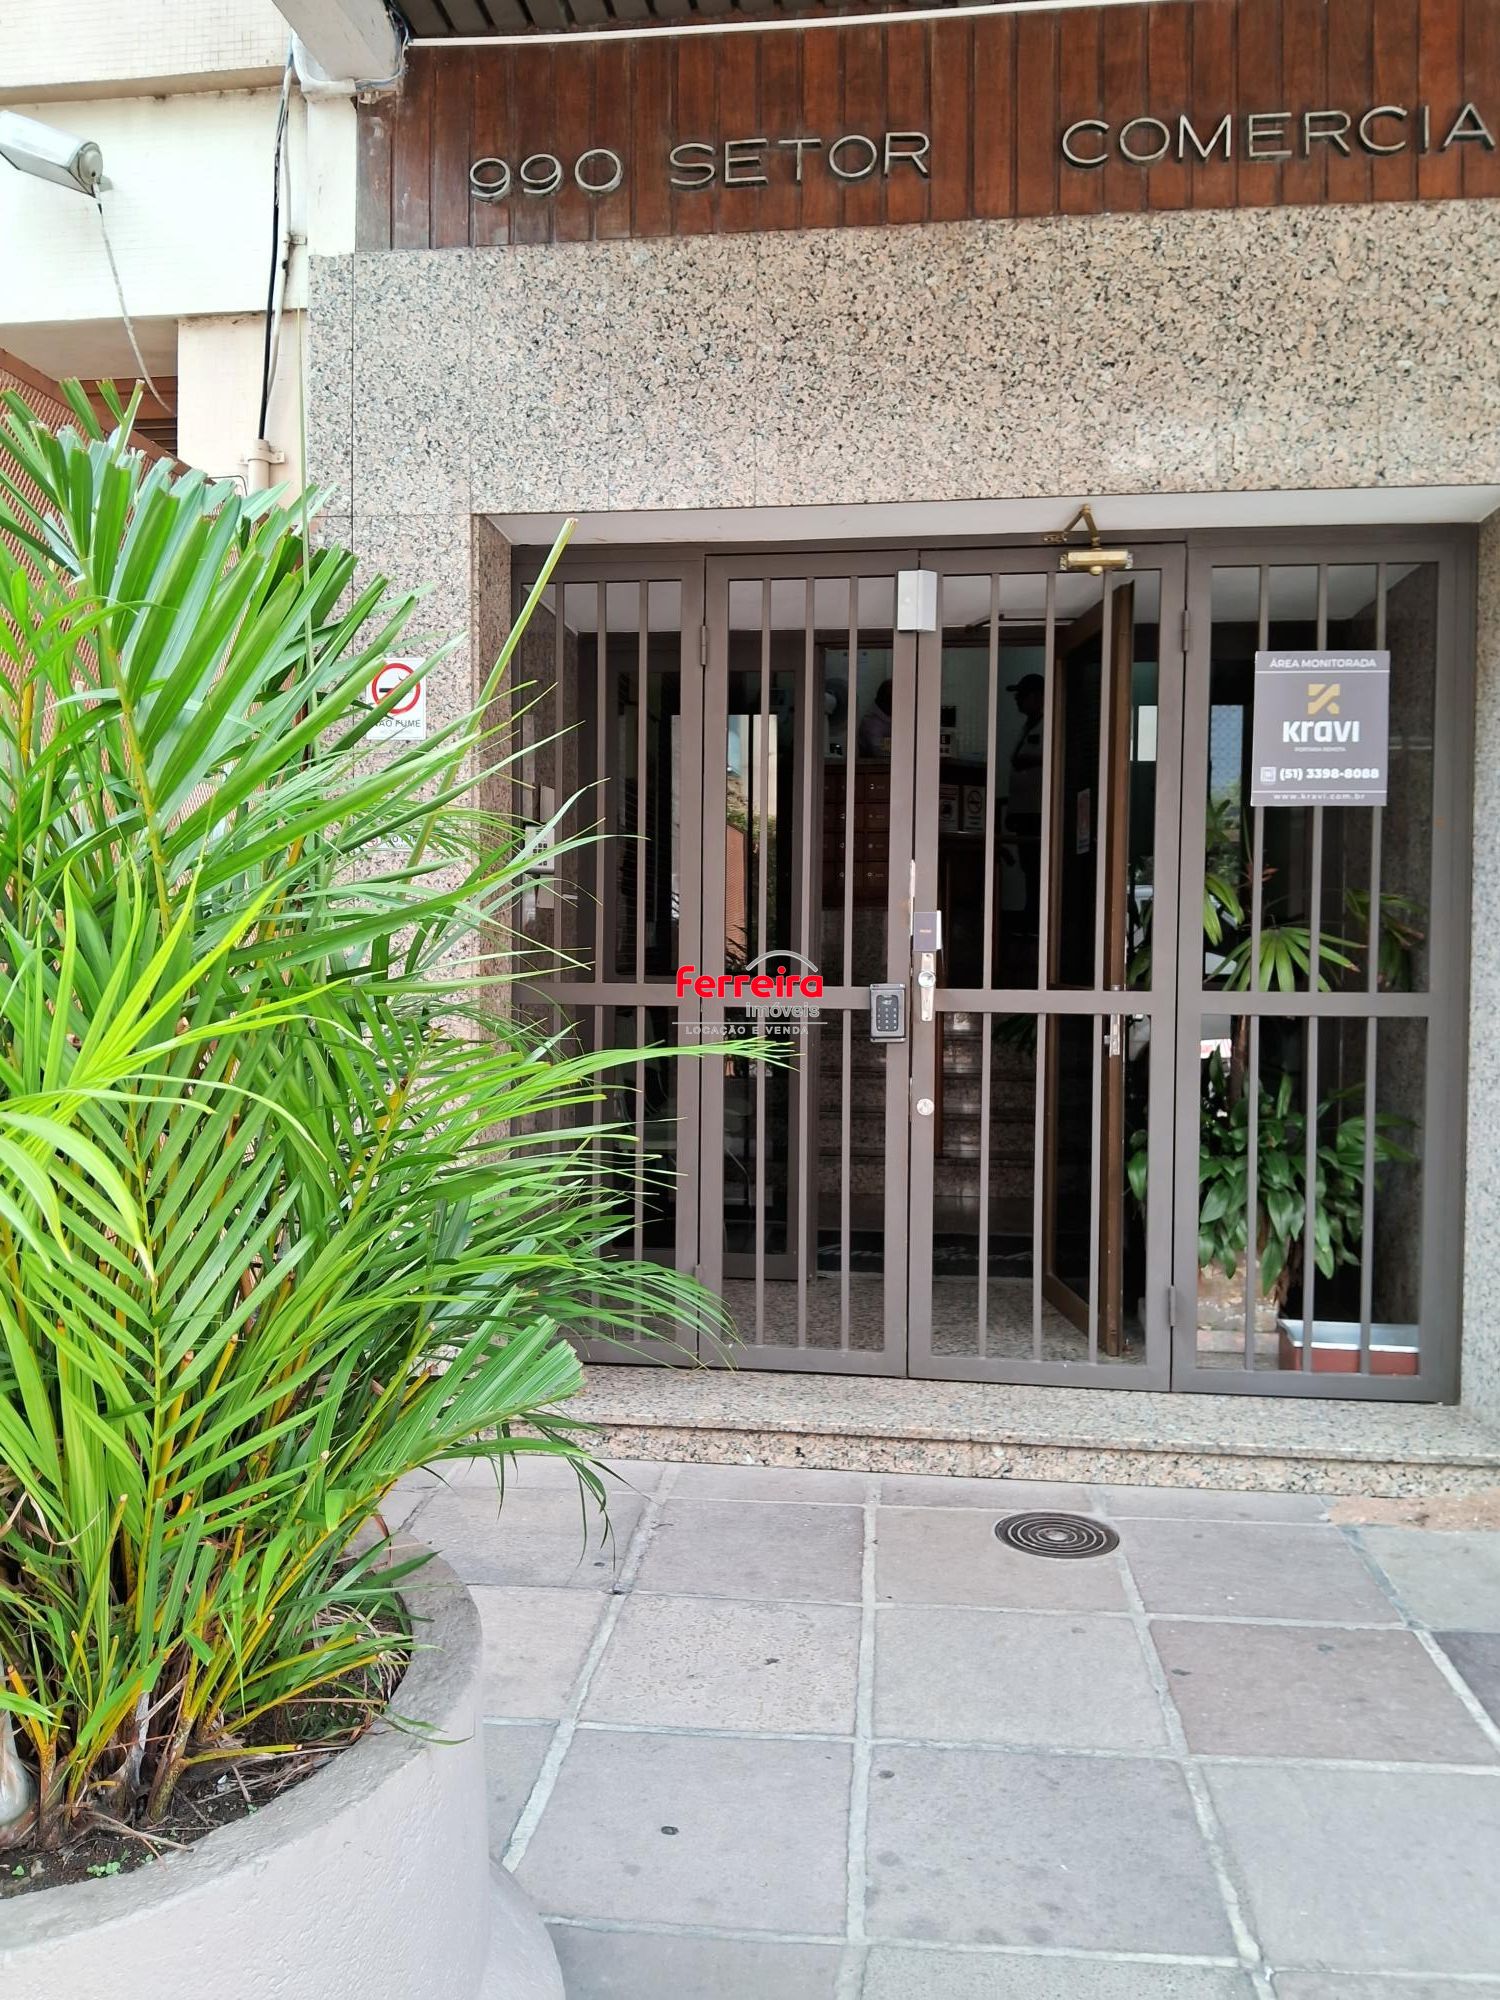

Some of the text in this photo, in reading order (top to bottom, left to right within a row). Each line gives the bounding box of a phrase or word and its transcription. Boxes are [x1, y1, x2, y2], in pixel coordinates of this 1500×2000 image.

[469, 102, 1496, 200] 990 SETOR COMERCIA
[1301, 658, 1377, 668] MONITORADA
[1279, 767, 1303, 781] (51)
